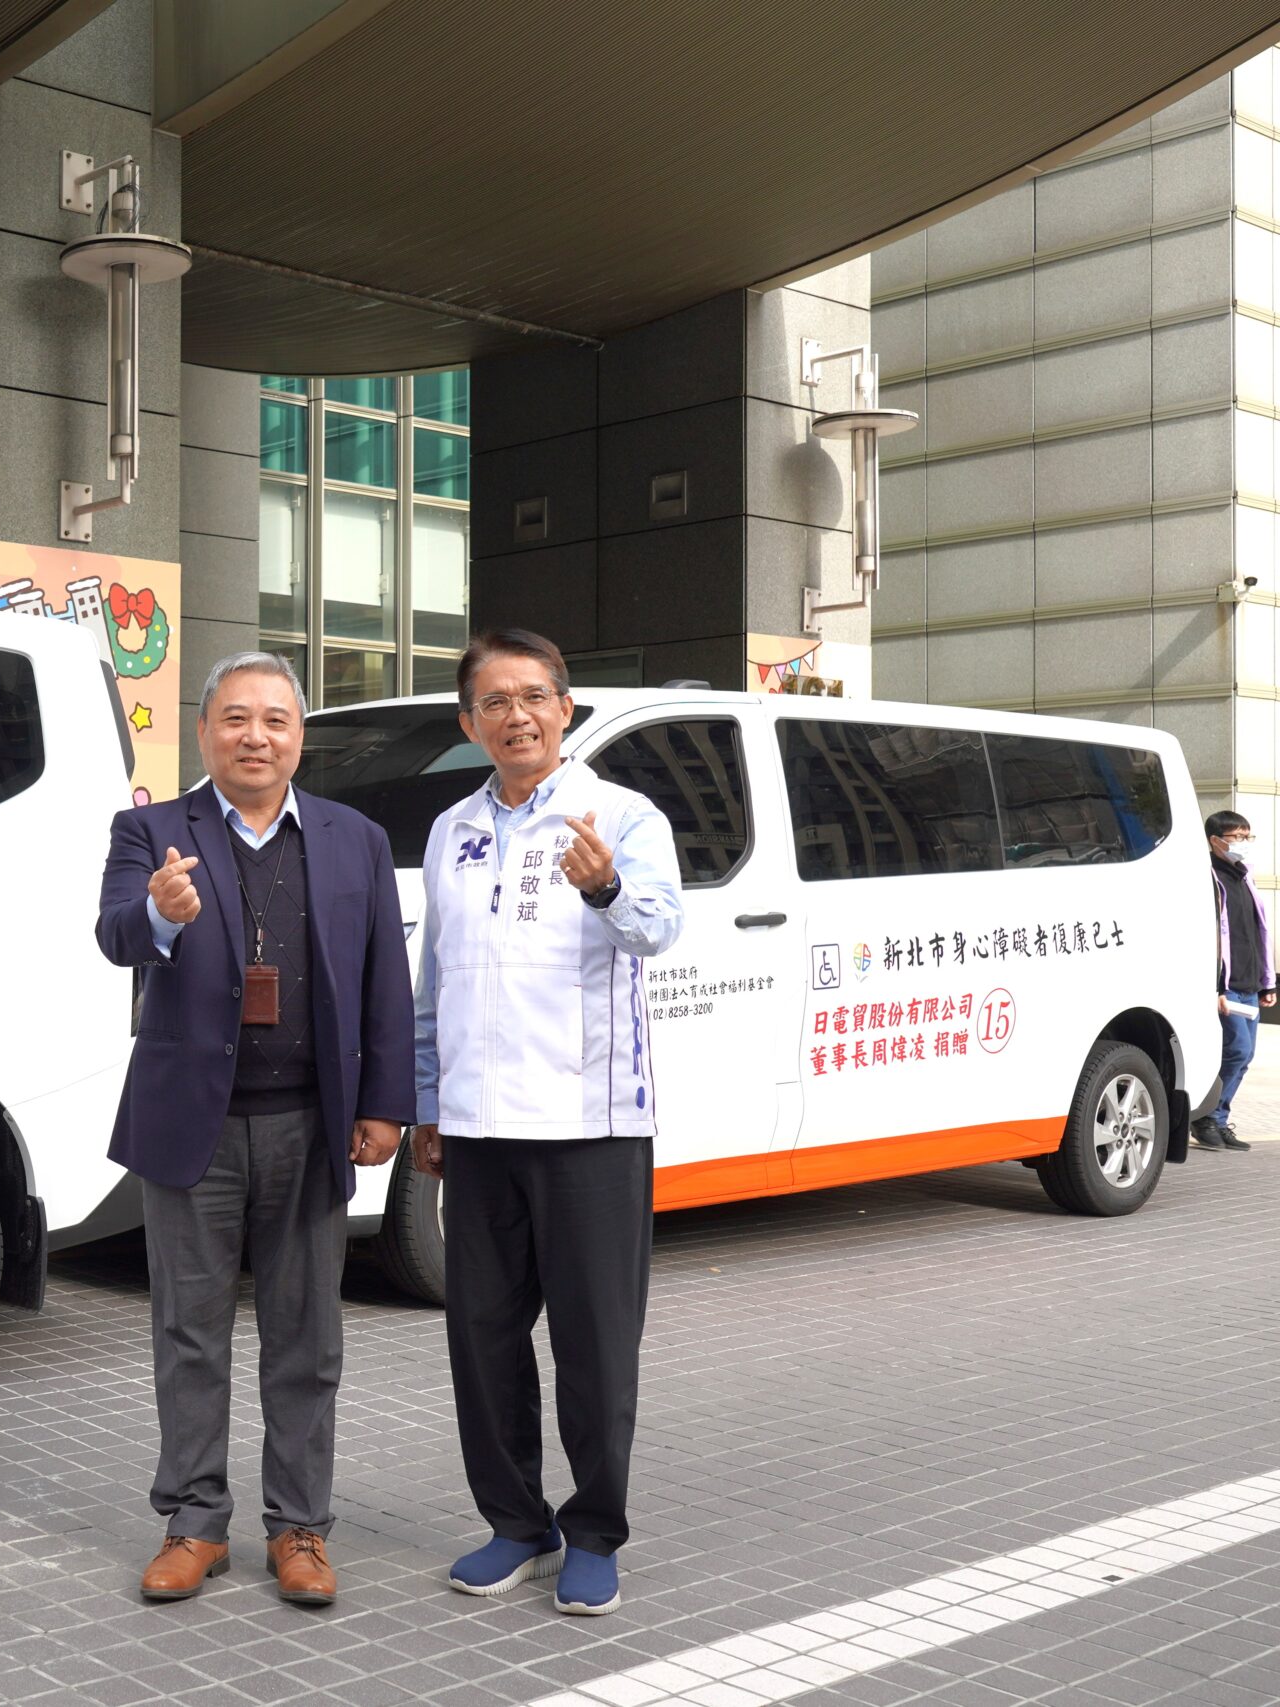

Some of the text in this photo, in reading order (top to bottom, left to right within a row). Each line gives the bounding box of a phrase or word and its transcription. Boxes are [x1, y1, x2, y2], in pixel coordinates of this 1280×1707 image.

[516, 850, 545, 922] 邱敬斌
[883, 920, 1125, 971] 新北市身心障礙者復康巴士
[648, 966, 698, 983] 新北市政府
[648, 975, 775, 1003] 財團法人育成社會福利基金會
[814, 993, 973, 1035] 日電貿股份有限公司
[810, 1028, 970, 1076] 董事長周煒凌 捐贈
